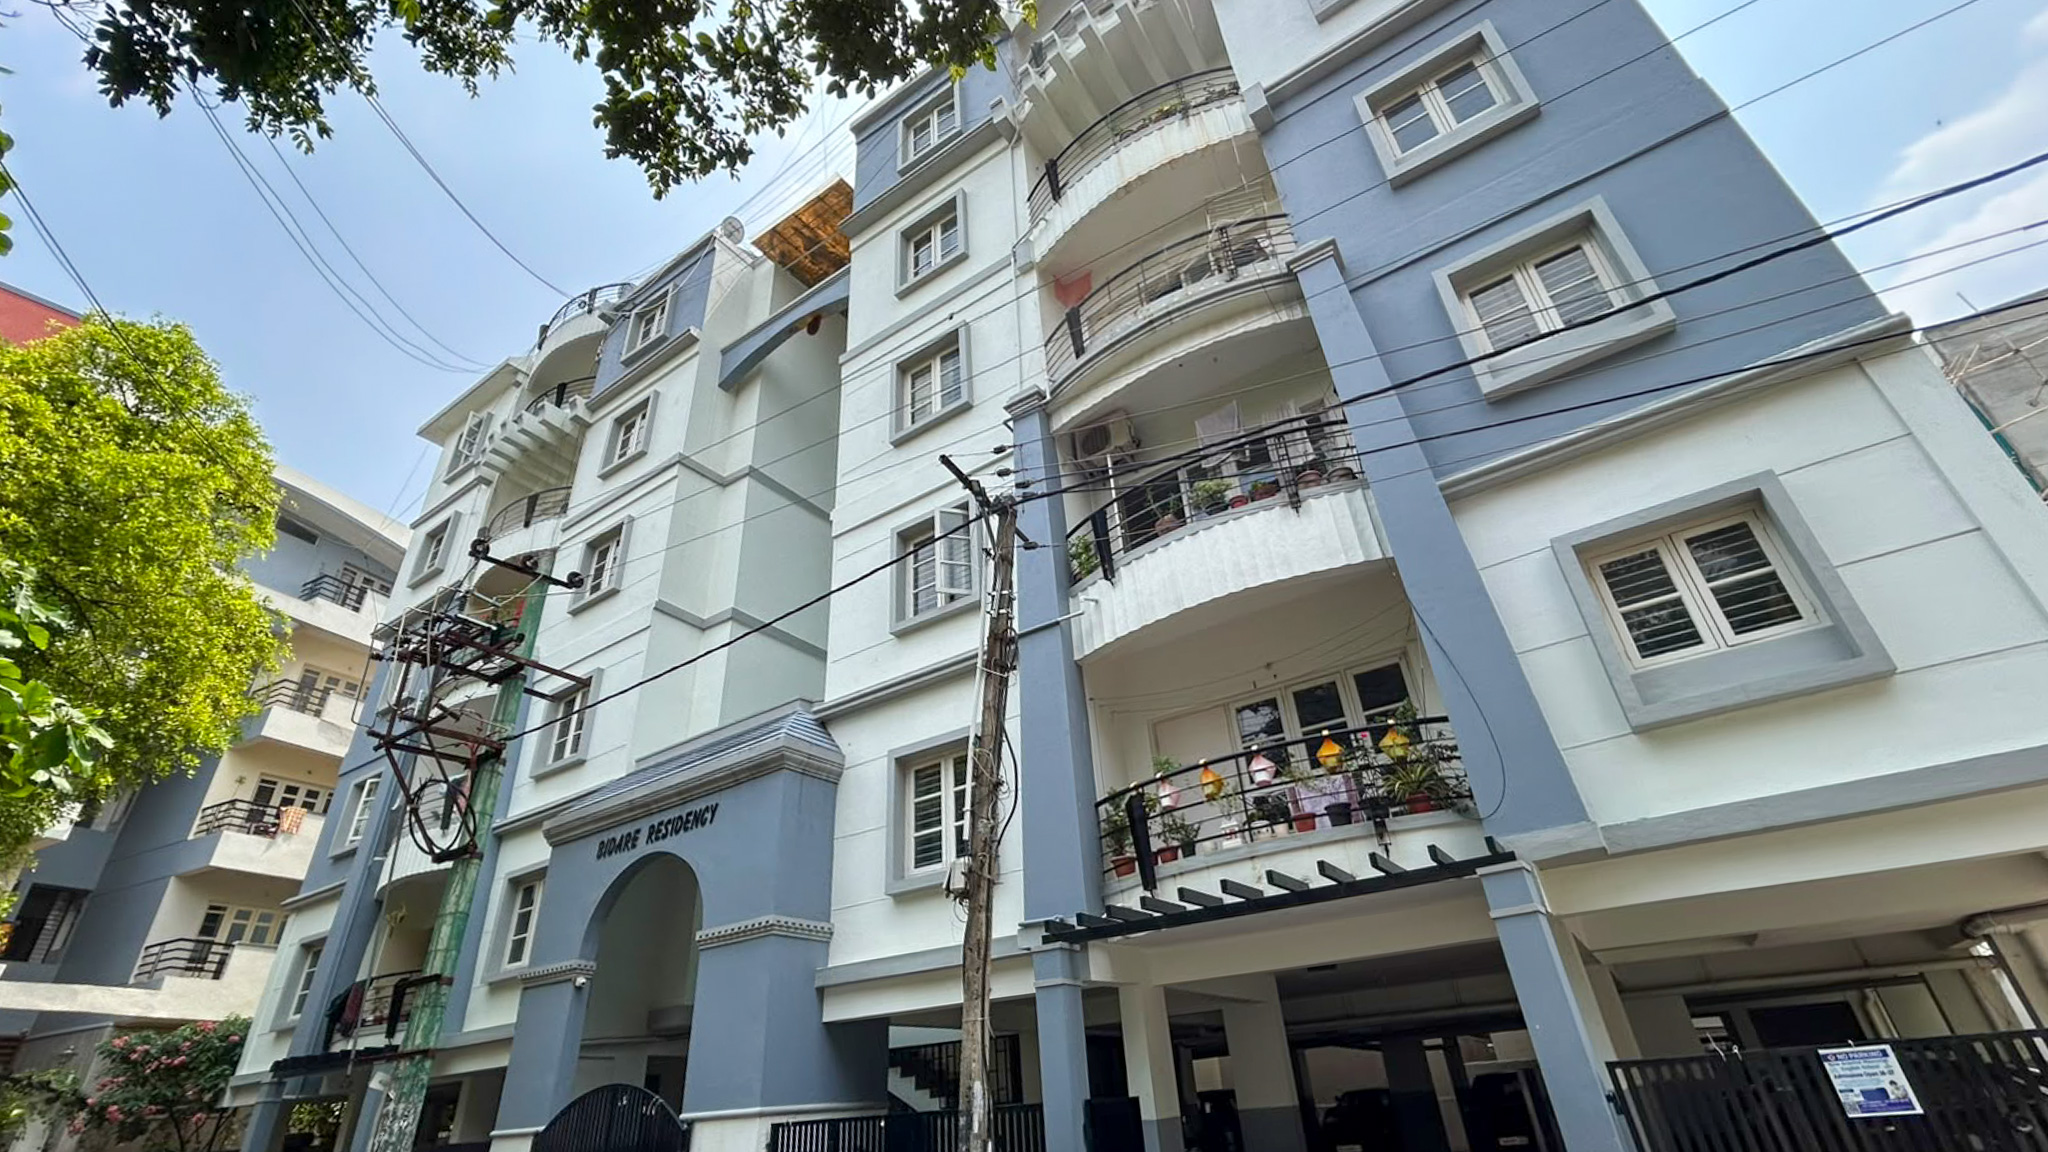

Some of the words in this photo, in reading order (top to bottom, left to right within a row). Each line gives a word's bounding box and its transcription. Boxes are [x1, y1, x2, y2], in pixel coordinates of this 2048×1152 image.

[596, 828, 641, 860] BIDARE
[645, 802, 719, 845] RESIDENCY
[1848, 1051, 1882, 1059] PARKING
